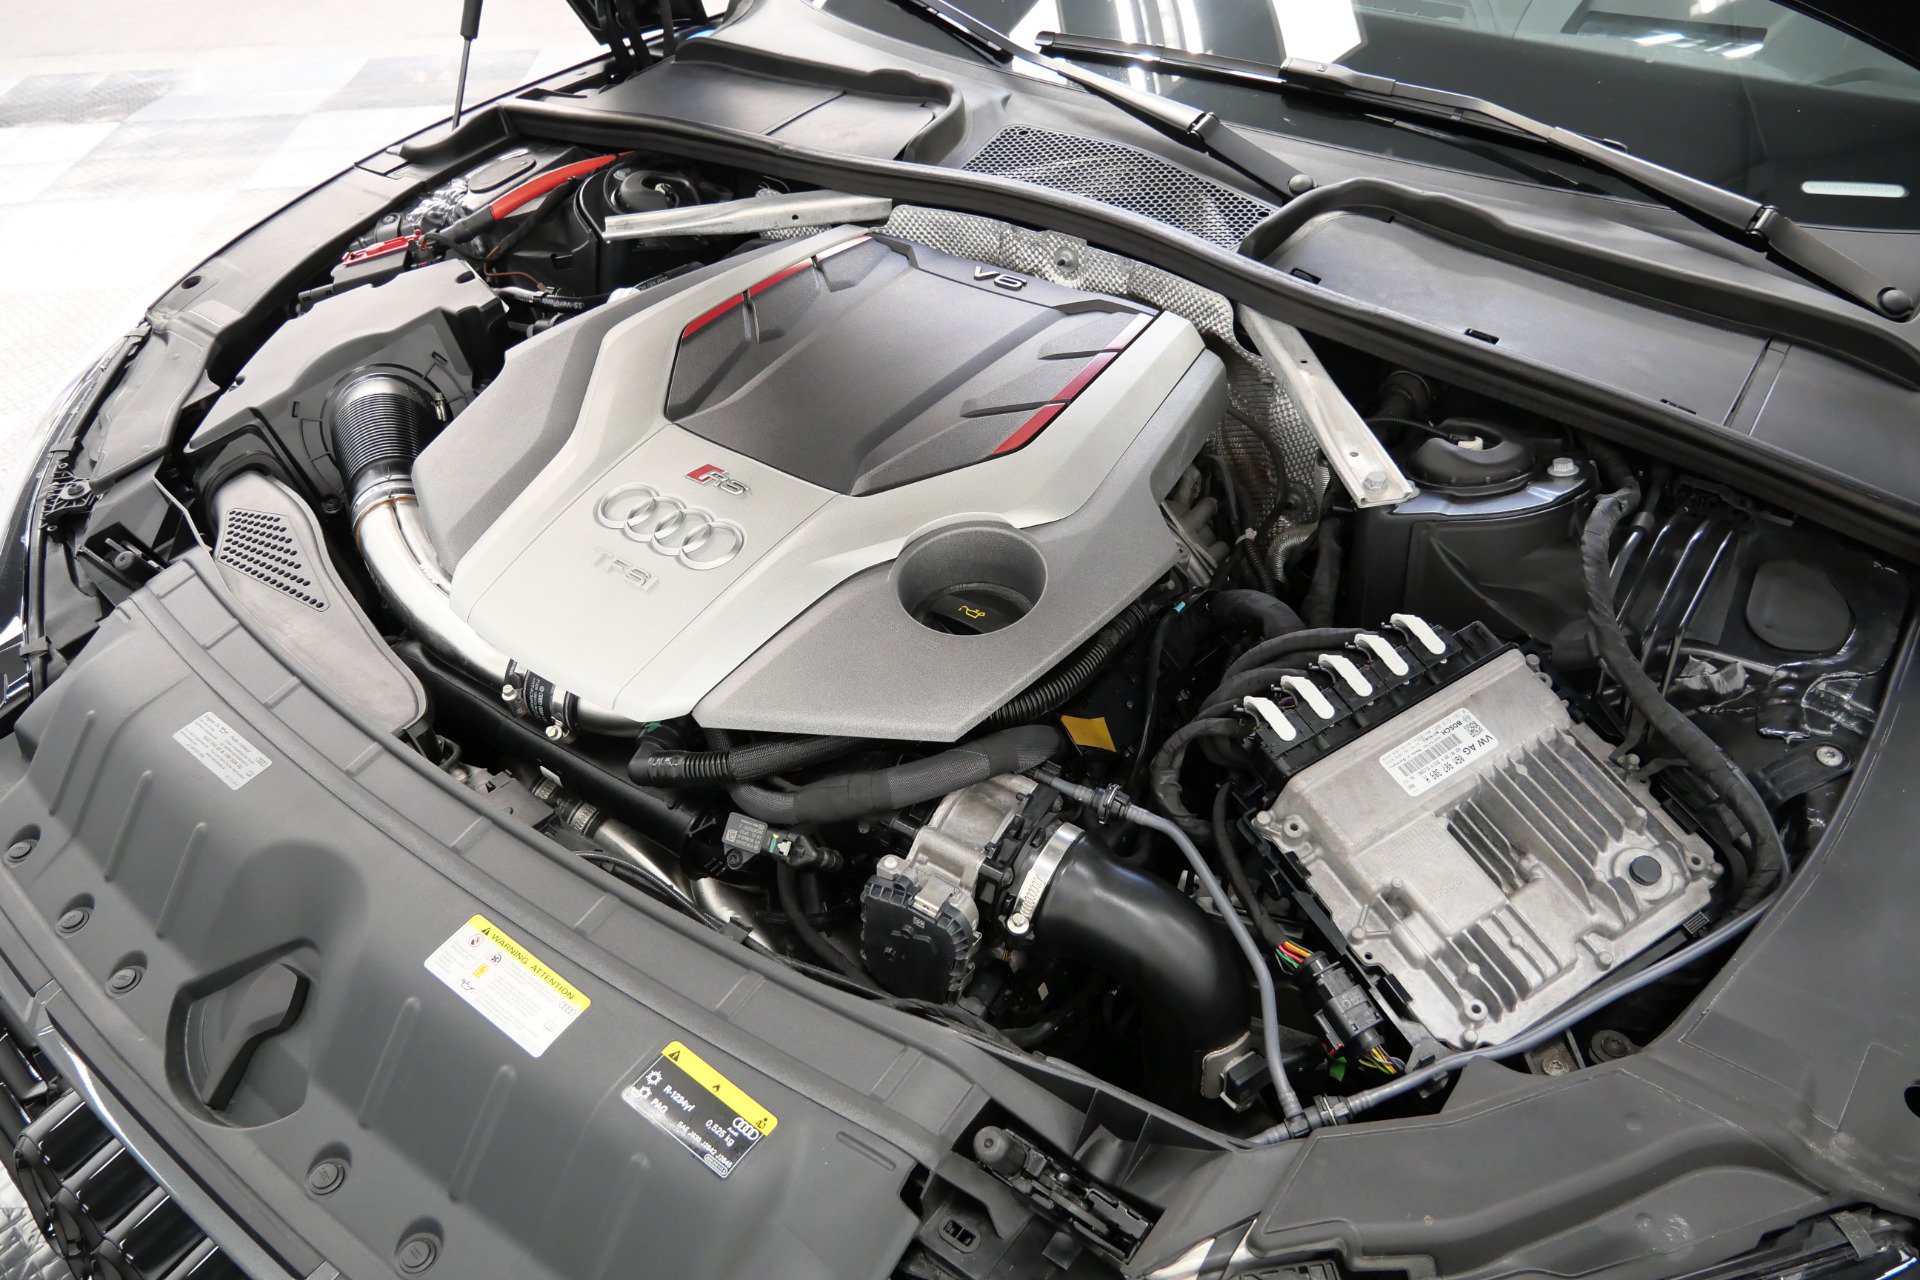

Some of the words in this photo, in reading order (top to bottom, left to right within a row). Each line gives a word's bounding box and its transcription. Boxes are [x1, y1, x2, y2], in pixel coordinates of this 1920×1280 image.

[974, 266, 1027, 291] V6
[690, 466, 750, 496] RS
[592, 546, 659, 593] TFSI
[1441, 720, 1463, 736] BOSCH
[1477, 734, 1493, 747] VW
[1463, 743, 1477, 756] AG
[491, 933, 529, 964] WARNING
[530, 965, 575, 1000] ATTENTION
[650, 1098, 669, 1114] PAG
[663, 1085, 696, 1112] R-1234yf
[677, 1121, 690, 1133] SAE
[705, 1119, 727, 1138] 0,525
[724, 1134, 735, 1147] kg
